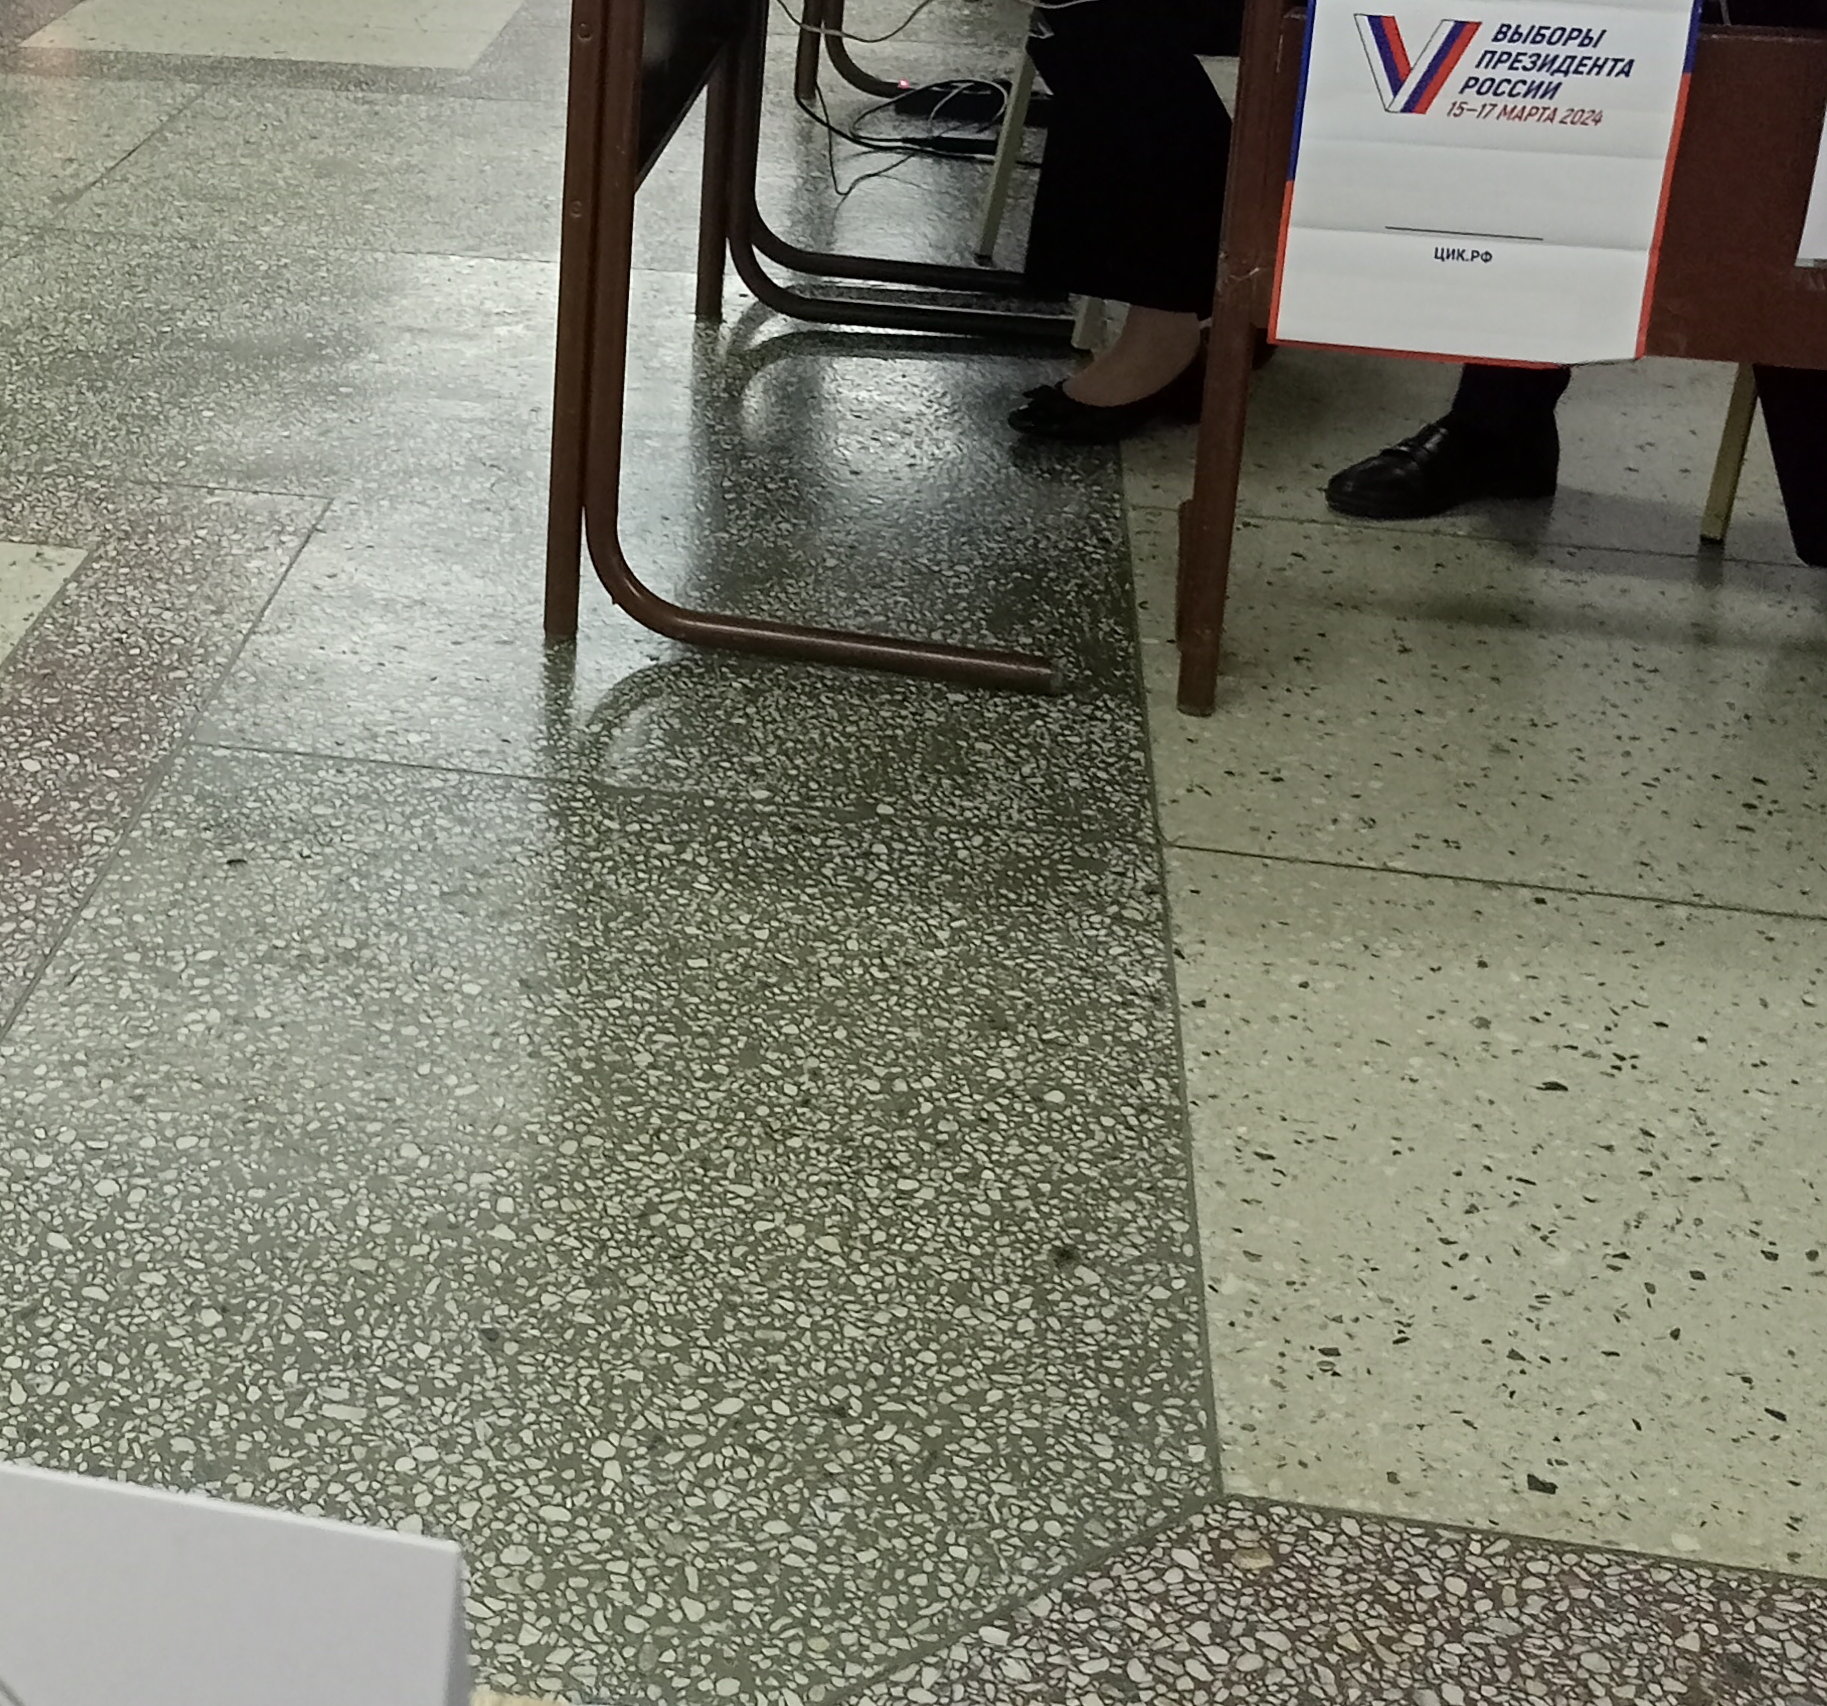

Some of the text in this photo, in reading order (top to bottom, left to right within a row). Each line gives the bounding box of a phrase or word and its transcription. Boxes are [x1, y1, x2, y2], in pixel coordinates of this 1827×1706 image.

[1491, 23, 1606, 48] ВЫБОРЫ
[1475, 50, 1635, 78] ПРЕЗИДЕНТА
[1458, 76, 1562, 100] РОССИИ
[1496, 106, 1556, 125] МАРТА
[1558, 107, 1603, 126] 2024
[1433, 247, 1493, 263] ЦИК.РФ
